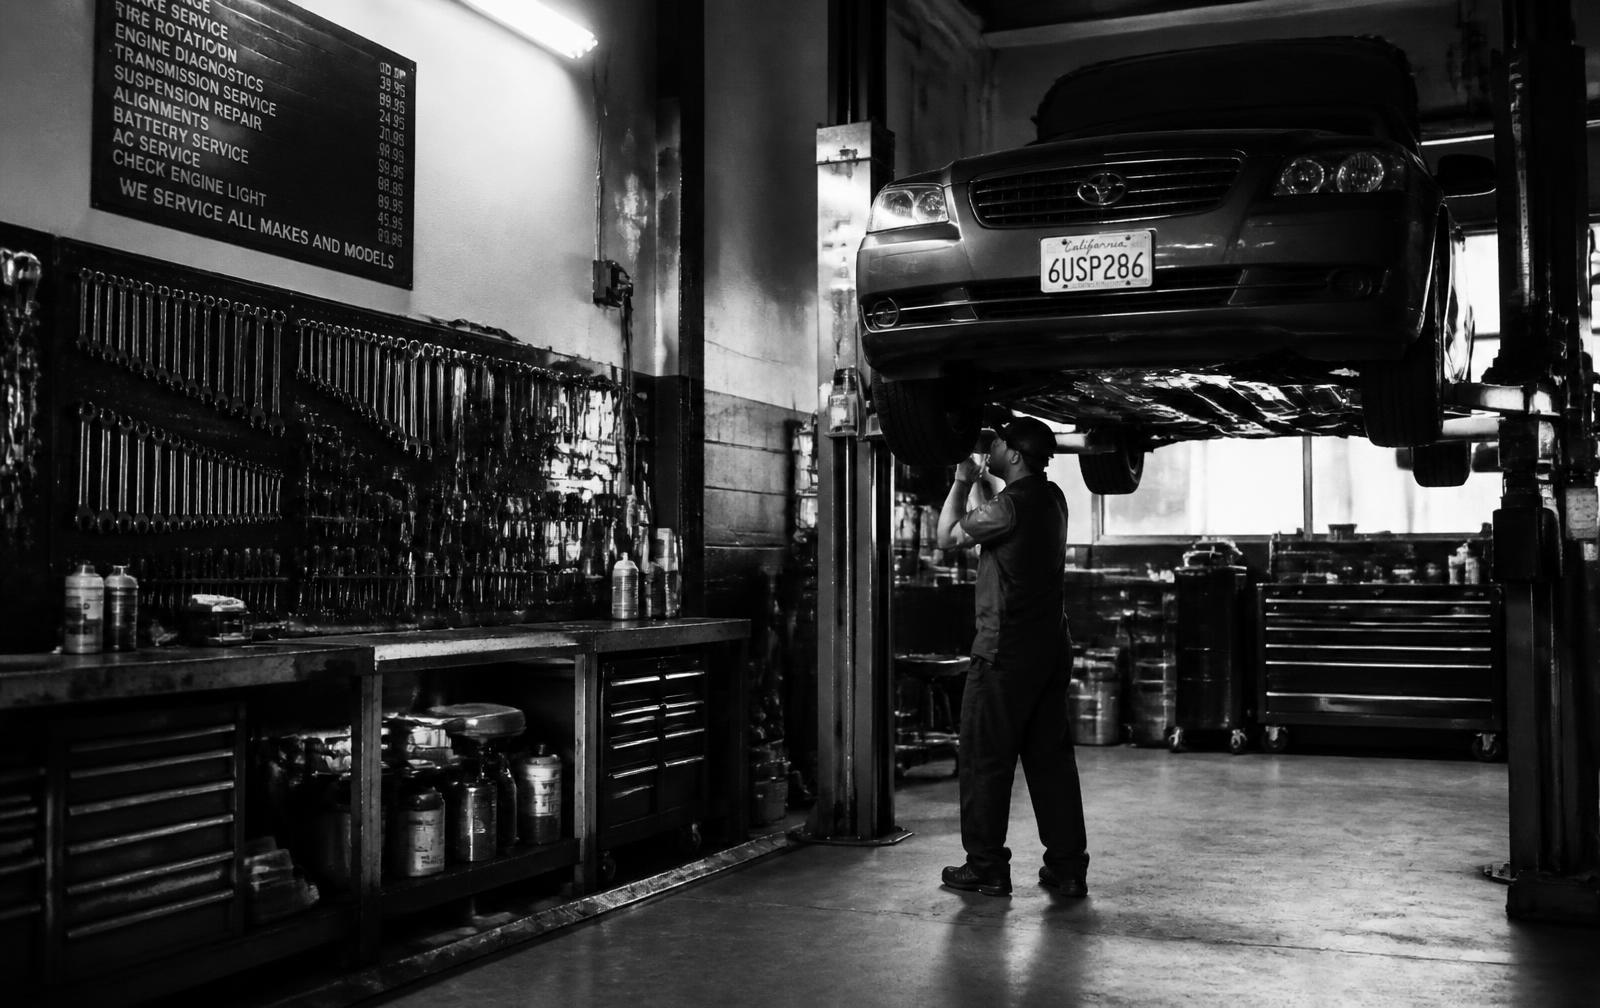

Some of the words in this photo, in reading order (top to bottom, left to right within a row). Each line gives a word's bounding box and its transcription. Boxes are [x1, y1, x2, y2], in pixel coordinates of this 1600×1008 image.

[171, 4, 228, 40] SERVICE
[116, 22, 170, 57] ENGINE
[175, 46, 264, 92] DIAGNOSTICS
[114, 65, 209, 111] SUSPENSION
[214, 101, 262, 131] REPAIR
[115, 43, 219, 96] TRANSMISSION
[223, 85, 276, 117] SERVICE
[113, 86, 209, 130] ALIGNMENTS
[113, 128, 134, 147] AC
[139, 135, 200, 168] SERVICE
[192, 133, 249, 164] SERVICE
[113, 149, 166, 178] CHECK
[171, 166, 224, 195] ENGINE
[228, 183, 267, 207] LIGHT
[120, 177, 148, 201] WE
[153, 187, 223, 222] SERVICE
[228, 210, 256, 231] ALL
[260, 218, 309, 245] MAKES
[312, 234, 341, 254] AND
[344, 242, 394, 269] MODELS
[1048, 252, 1143, 283] 6USP286
[1065, 238, 1127, 255] California
